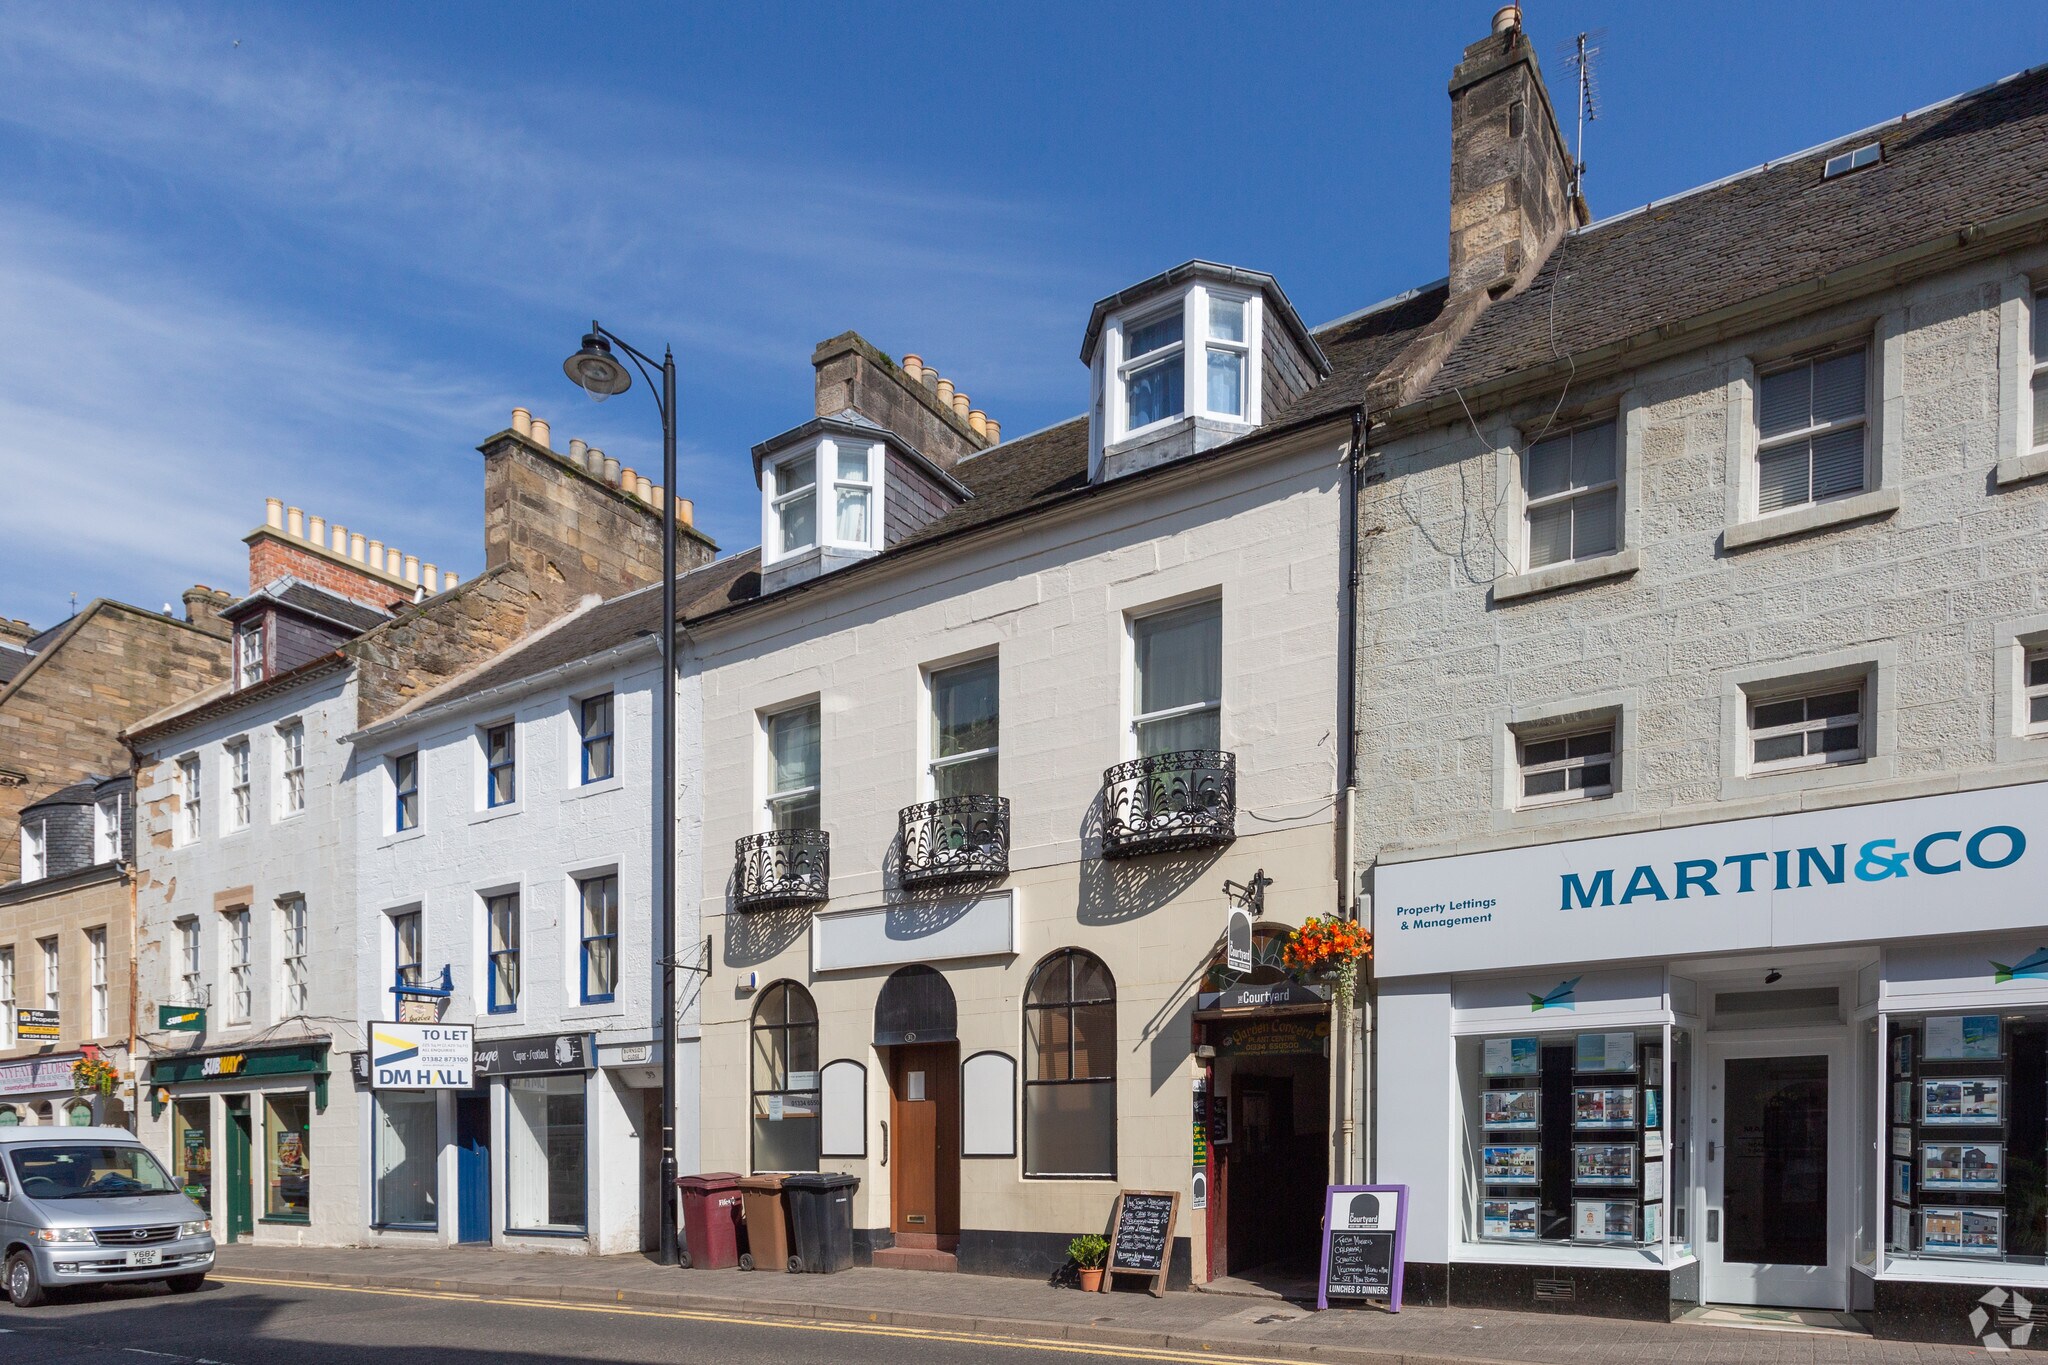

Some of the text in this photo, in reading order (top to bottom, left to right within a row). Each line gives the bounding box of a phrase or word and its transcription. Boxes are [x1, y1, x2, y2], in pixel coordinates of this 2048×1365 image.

[1396, 898, 1497, 916] Property Lettings
[1400, 913, 1492, 930] & Management
[1230, 945, 1250, 961] Courtyard
[1243, 988, 1290, 1004] Courtyard
[166, 1012, 199, 1026] SUBWAY
[422, 1030, 468, 1040] TO LET
[1232, 1020, 1314, 1045] Garden Concern
[1246, 1043, 1266, 1051] 01334
[201, 1054, 244, 1076] SUBWAY
[380, 1070, 468, 1085] DM HALL
[1350, 1215, 1378, 1224] Courtyard
[1329, 1285, 1356, 1294] LUNCHES
[1362, 1286, 1388, 1294] DINNERS
